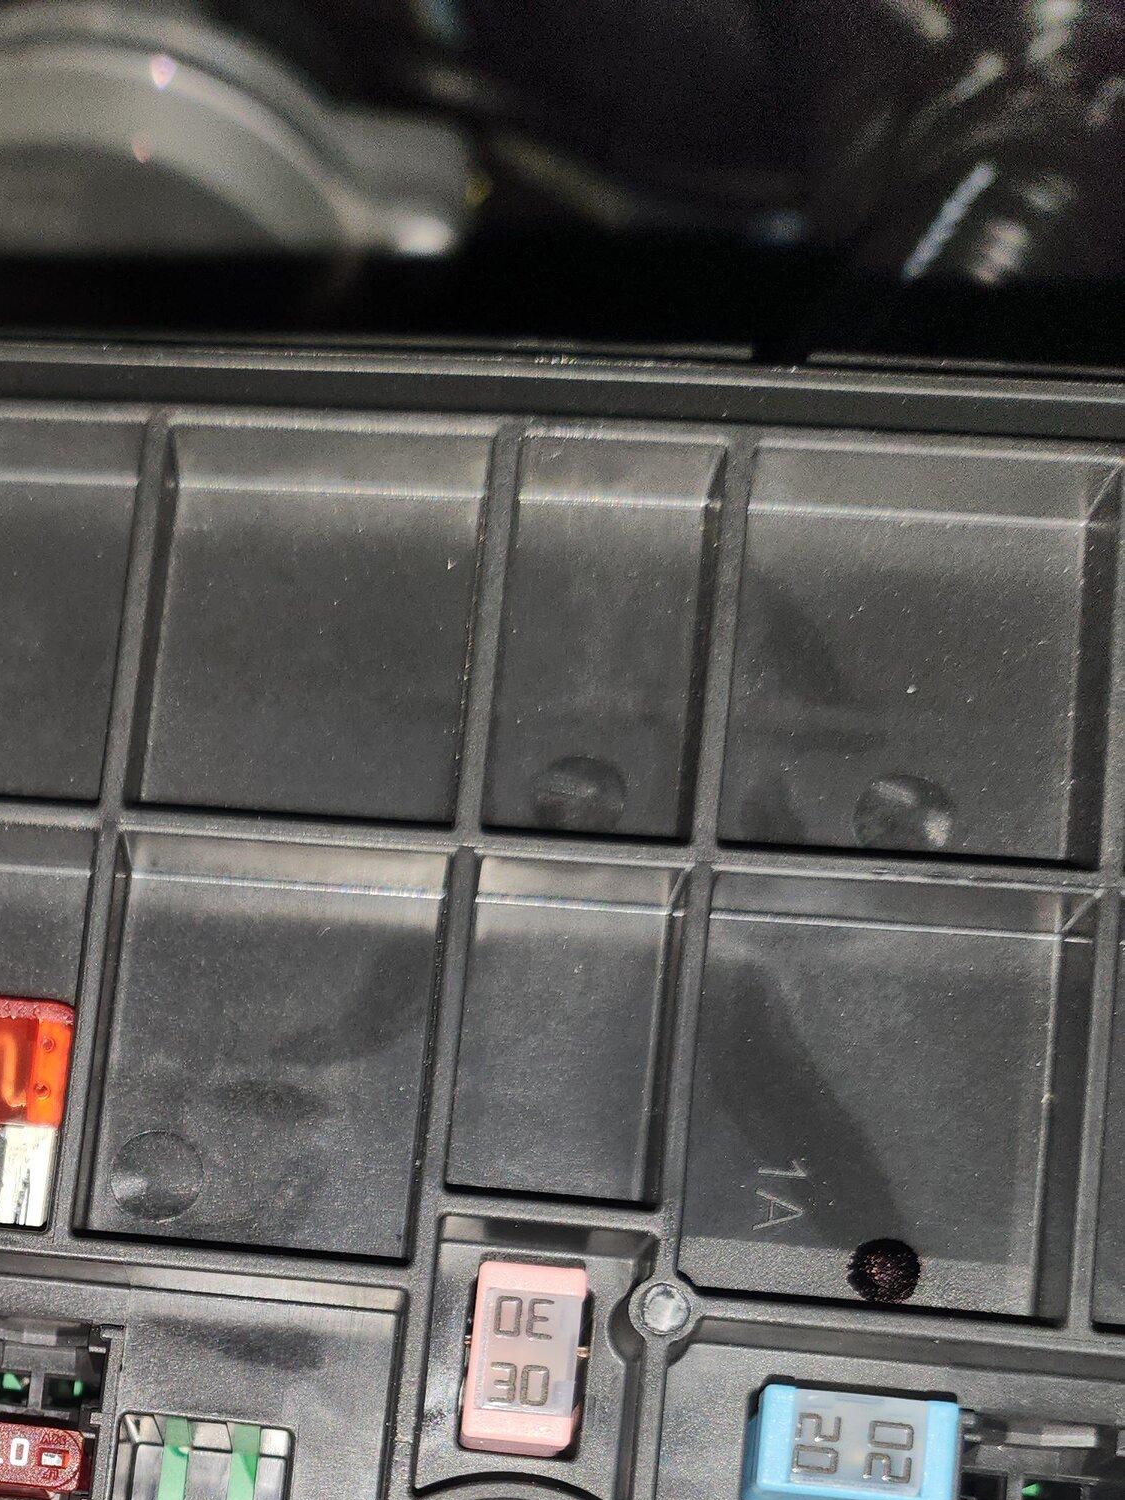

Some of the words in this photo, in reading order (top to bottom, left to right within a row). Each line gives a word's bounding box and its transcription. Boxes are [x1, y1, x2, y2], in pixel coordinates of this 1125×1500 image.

[493, 1295, 555, 1340] 30
[488, 1361, 550, 1406] 30
[792, 1412, 842, 1474] 20
[862, 1420, 914, 1484] 20
